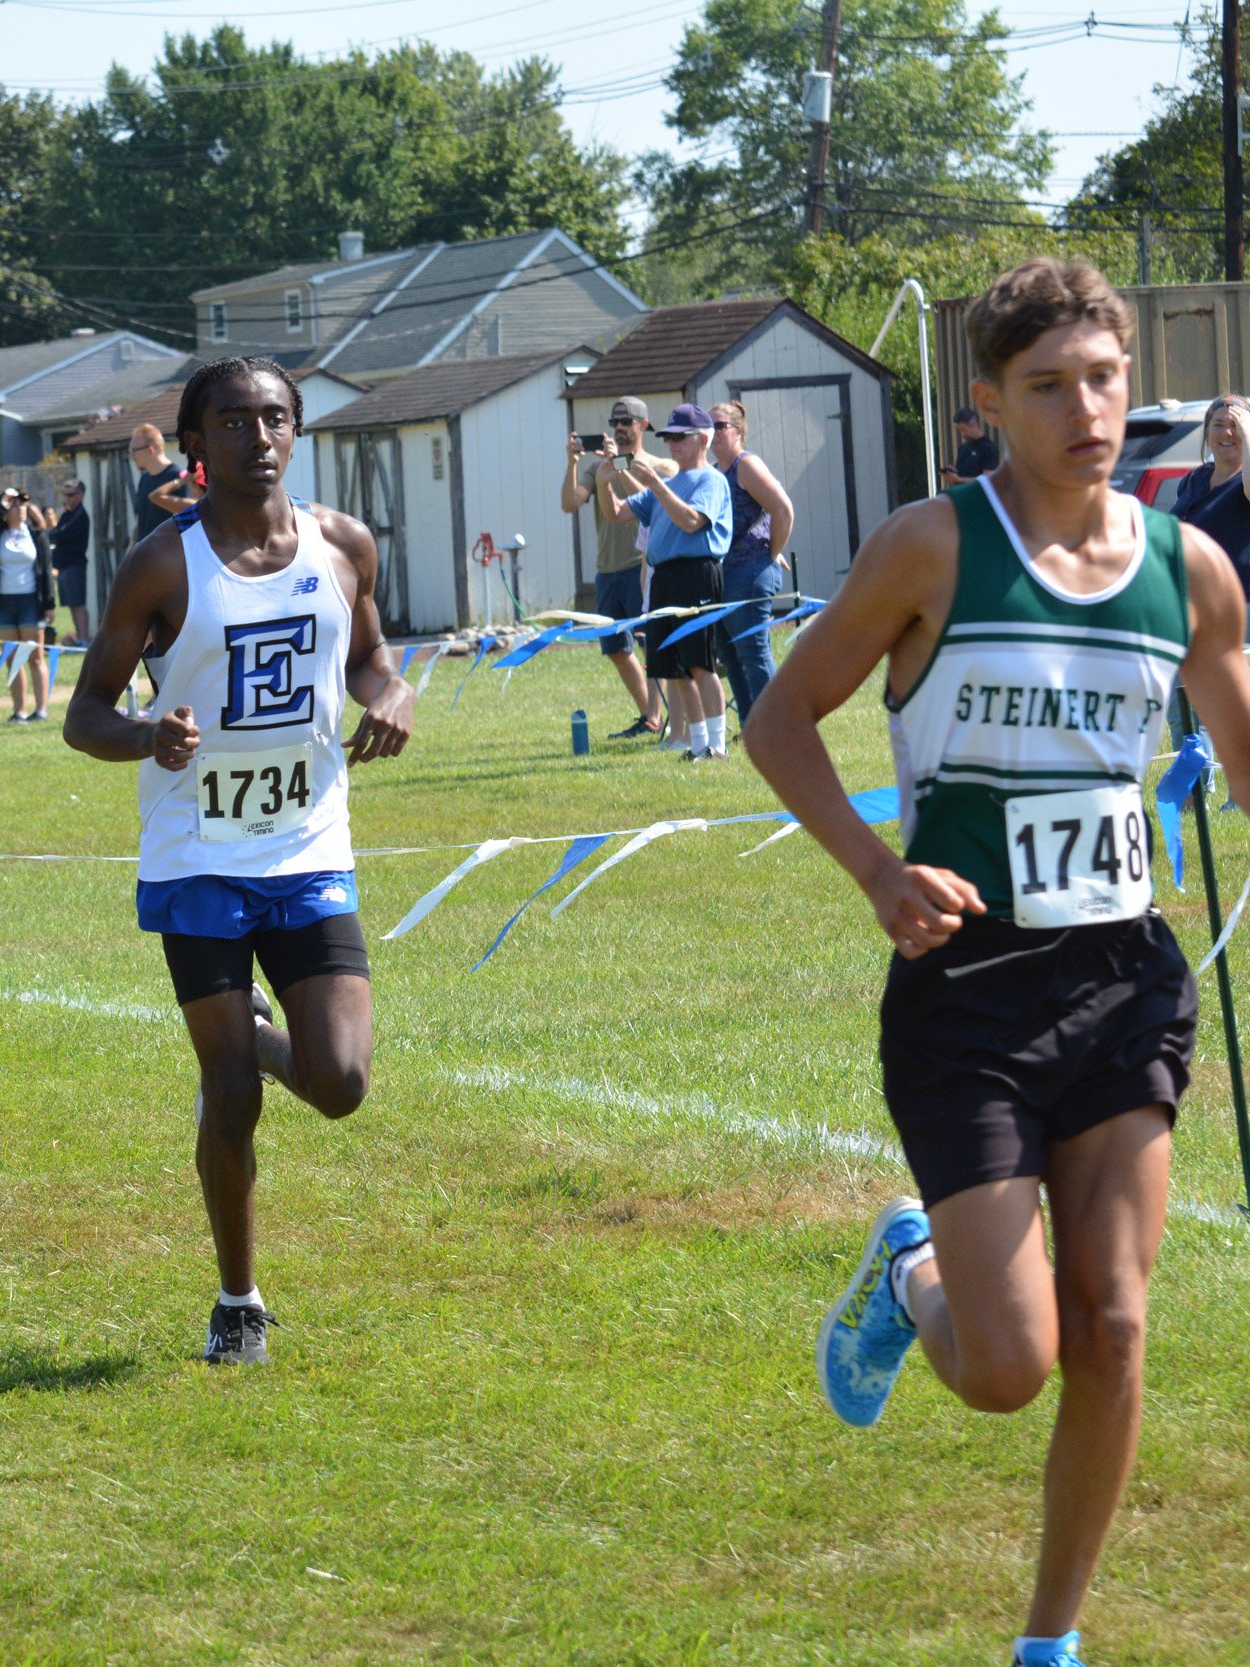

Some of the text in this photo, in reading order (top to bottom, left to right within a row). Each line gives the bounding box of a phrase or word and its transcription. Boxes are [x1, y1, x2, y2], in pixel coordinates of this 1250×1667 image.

[221, 613, 317, 731] E
[955, 684, 1125, 732] STEINERT
[202, 760, 310, 819] 1734
[1015, 811, 1144, 895] 1748
